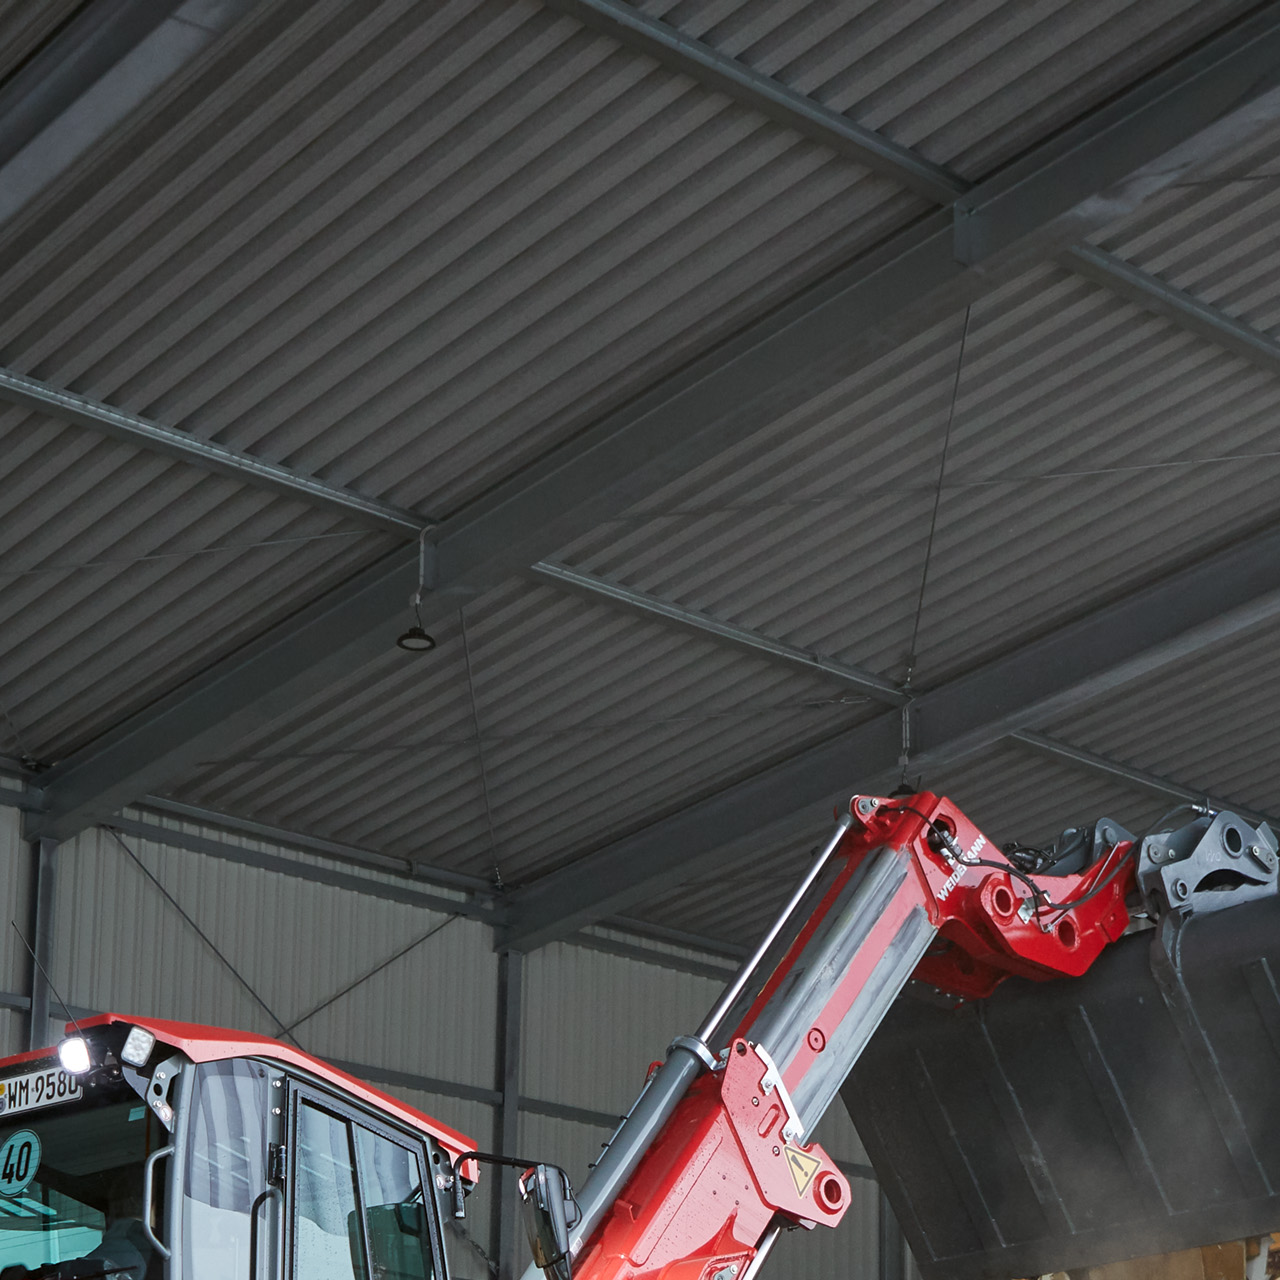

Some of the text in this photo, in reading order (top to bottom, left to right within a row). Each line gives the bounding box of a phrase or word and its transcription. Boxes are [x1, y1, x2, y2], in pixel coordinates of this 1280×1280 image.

[937, 834, 986, 901] WEIDEANN
[8, 1079, 29, 1109] WM
[1, 1141, 32, 1184] 40
